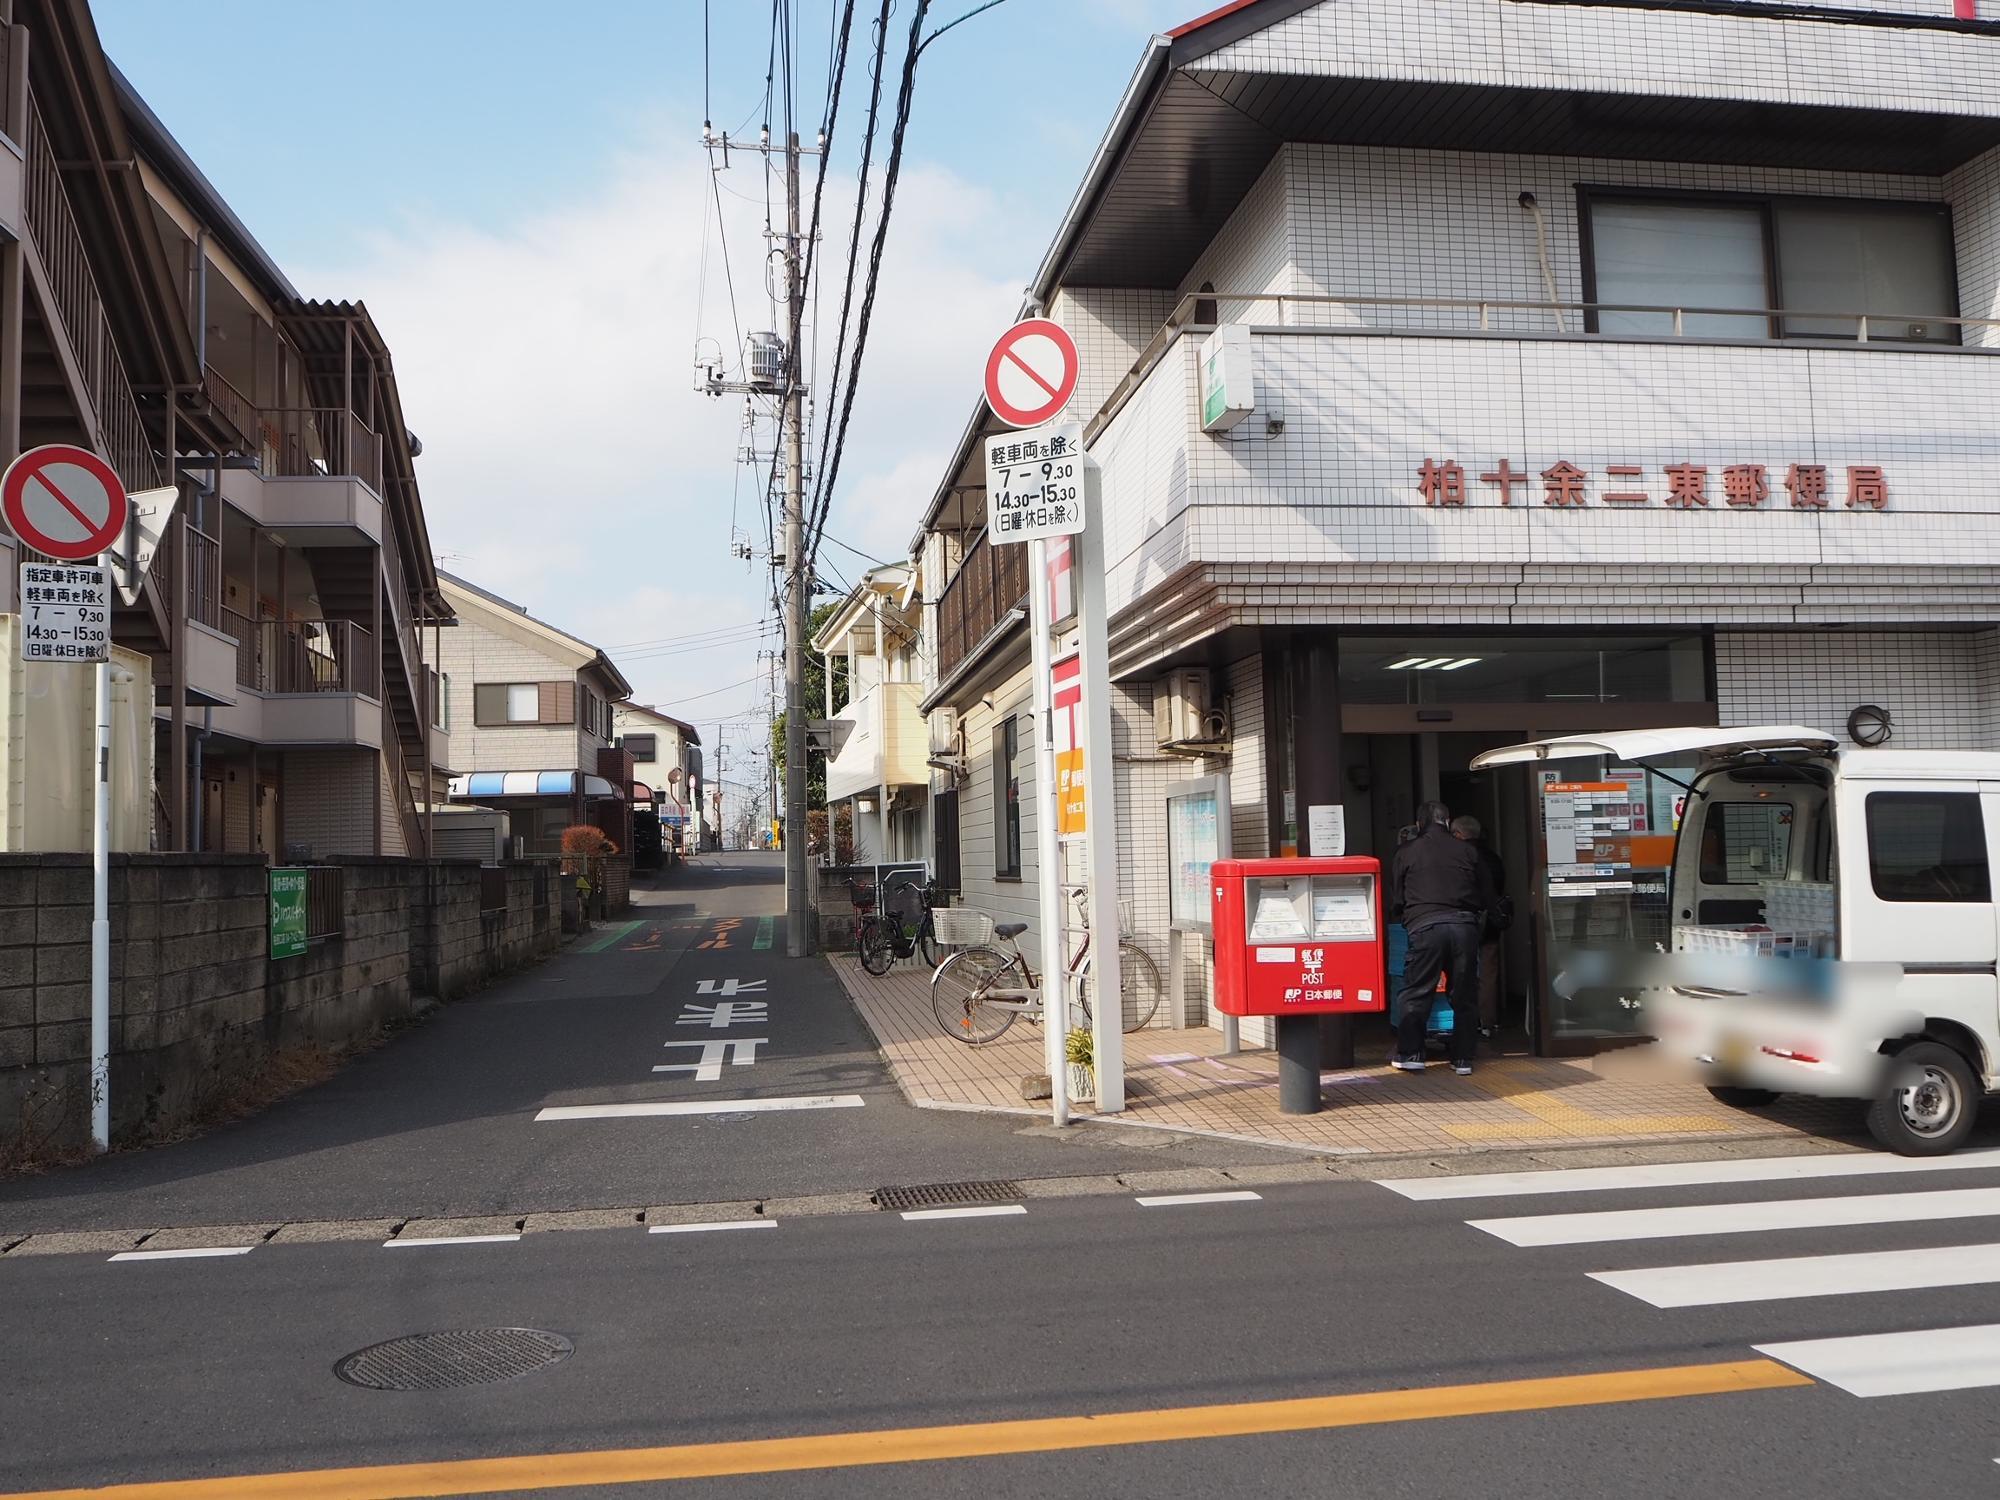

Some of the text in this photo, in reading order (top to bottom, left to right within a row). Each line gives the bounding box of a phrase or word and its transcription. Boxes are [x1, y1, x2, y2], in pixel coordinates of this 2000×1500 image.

[991, 436, 1078, 466] 軽車両を除く
[998, 469, 1011, 488] 7
[1417, 457, 1890, 511] 柏十余二東郵便局
[26, 568, 104, 585] 指定車・許可車
[26, 587, 104, 604] 軽車両を除く
[31, 606, 41, 620] 7
[1301, 948, 1324, 962] 郵便
[1301, 973, 1325, 985] POST
[1305, 989, 1343, 1001] 日本郵便
